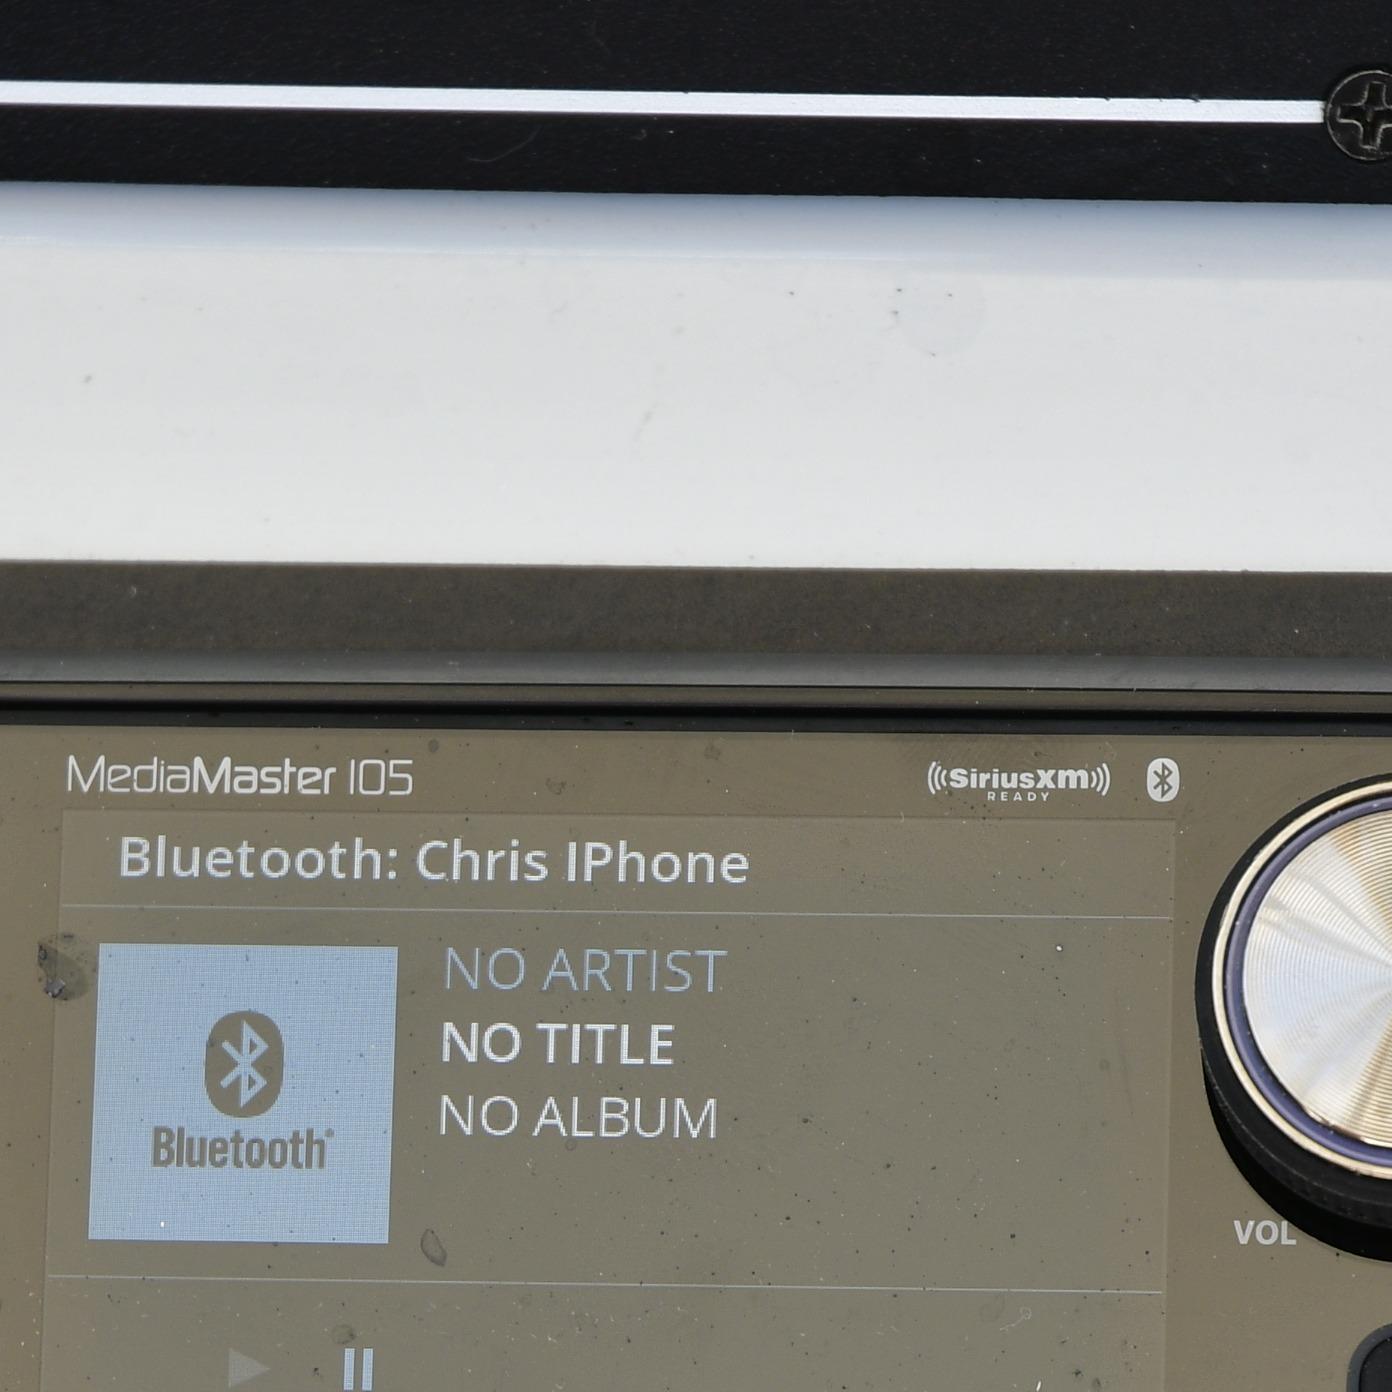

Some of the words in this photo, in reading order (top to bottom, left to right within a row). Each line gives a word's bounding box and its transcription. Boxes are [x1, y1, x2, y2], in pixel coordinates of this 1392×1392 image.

[66, 754, 337, 796] MediaMaster
[349, 758, 414, 796] 105
[986, 791, 1050, 802] READY
[119, 834, 398, 880] Bluetooth:
[416, 838, 549, 883] Chris
[566, 839, 750, 884] IPhone
[444, 947, 525, 991] NO
[542, 948, 729, 993] ARTIST
[441, 1021, 521, 1063] NO
[536, 1023, 675, 1065] TITLE
[439, 1094, 518, 1137] NO
[532, 1096, 718, 1139] ALBUM
[151, 1125, 326, 1170] Bluetooth
[1233, 1219, 1297, 1246] VOL
